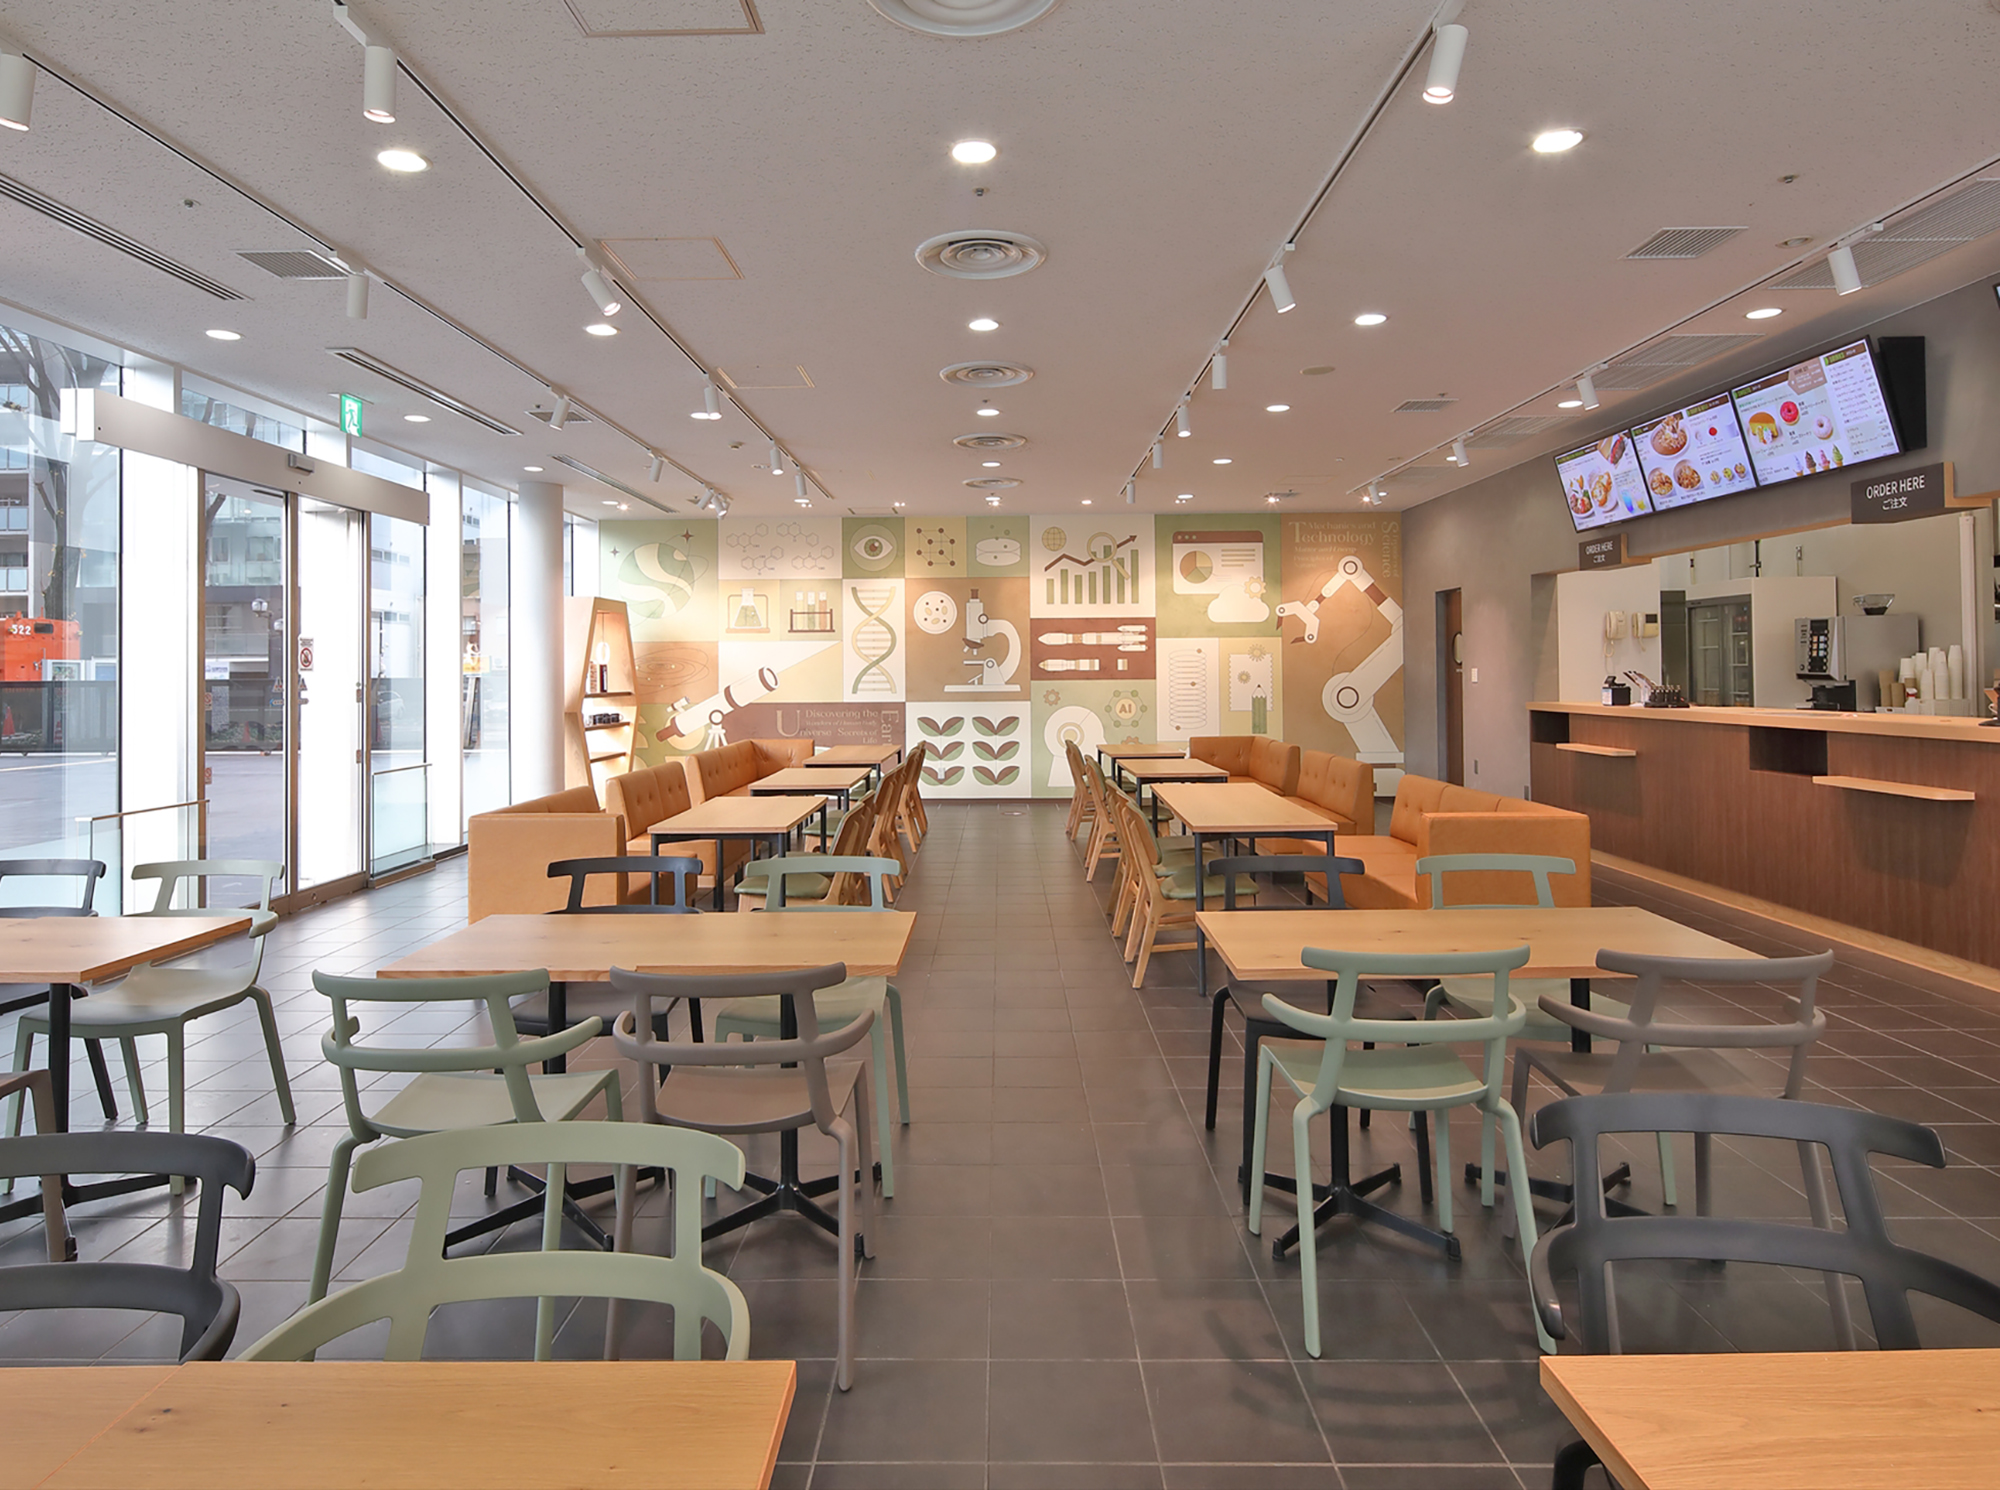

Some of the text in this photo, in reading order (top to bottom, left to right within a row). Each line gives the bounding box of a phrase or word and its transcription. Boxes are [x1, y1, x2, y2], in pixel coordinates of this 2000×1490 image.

[1866, 474, 1926, 499] ORDER HERE
[1882, 496, 1908, 510] ご注文
[1381, 521, 1399, 578] Science
[1585, 541, 1613, 555] ORDER HERE
[11, 624, 31, 635] 522
[806, 709, 878, 719] Discovering the
[1119, 703, 1132, 714] AI
[837, 727, 878, 736] Secrets of
[862, 736, 878, 744] Life
